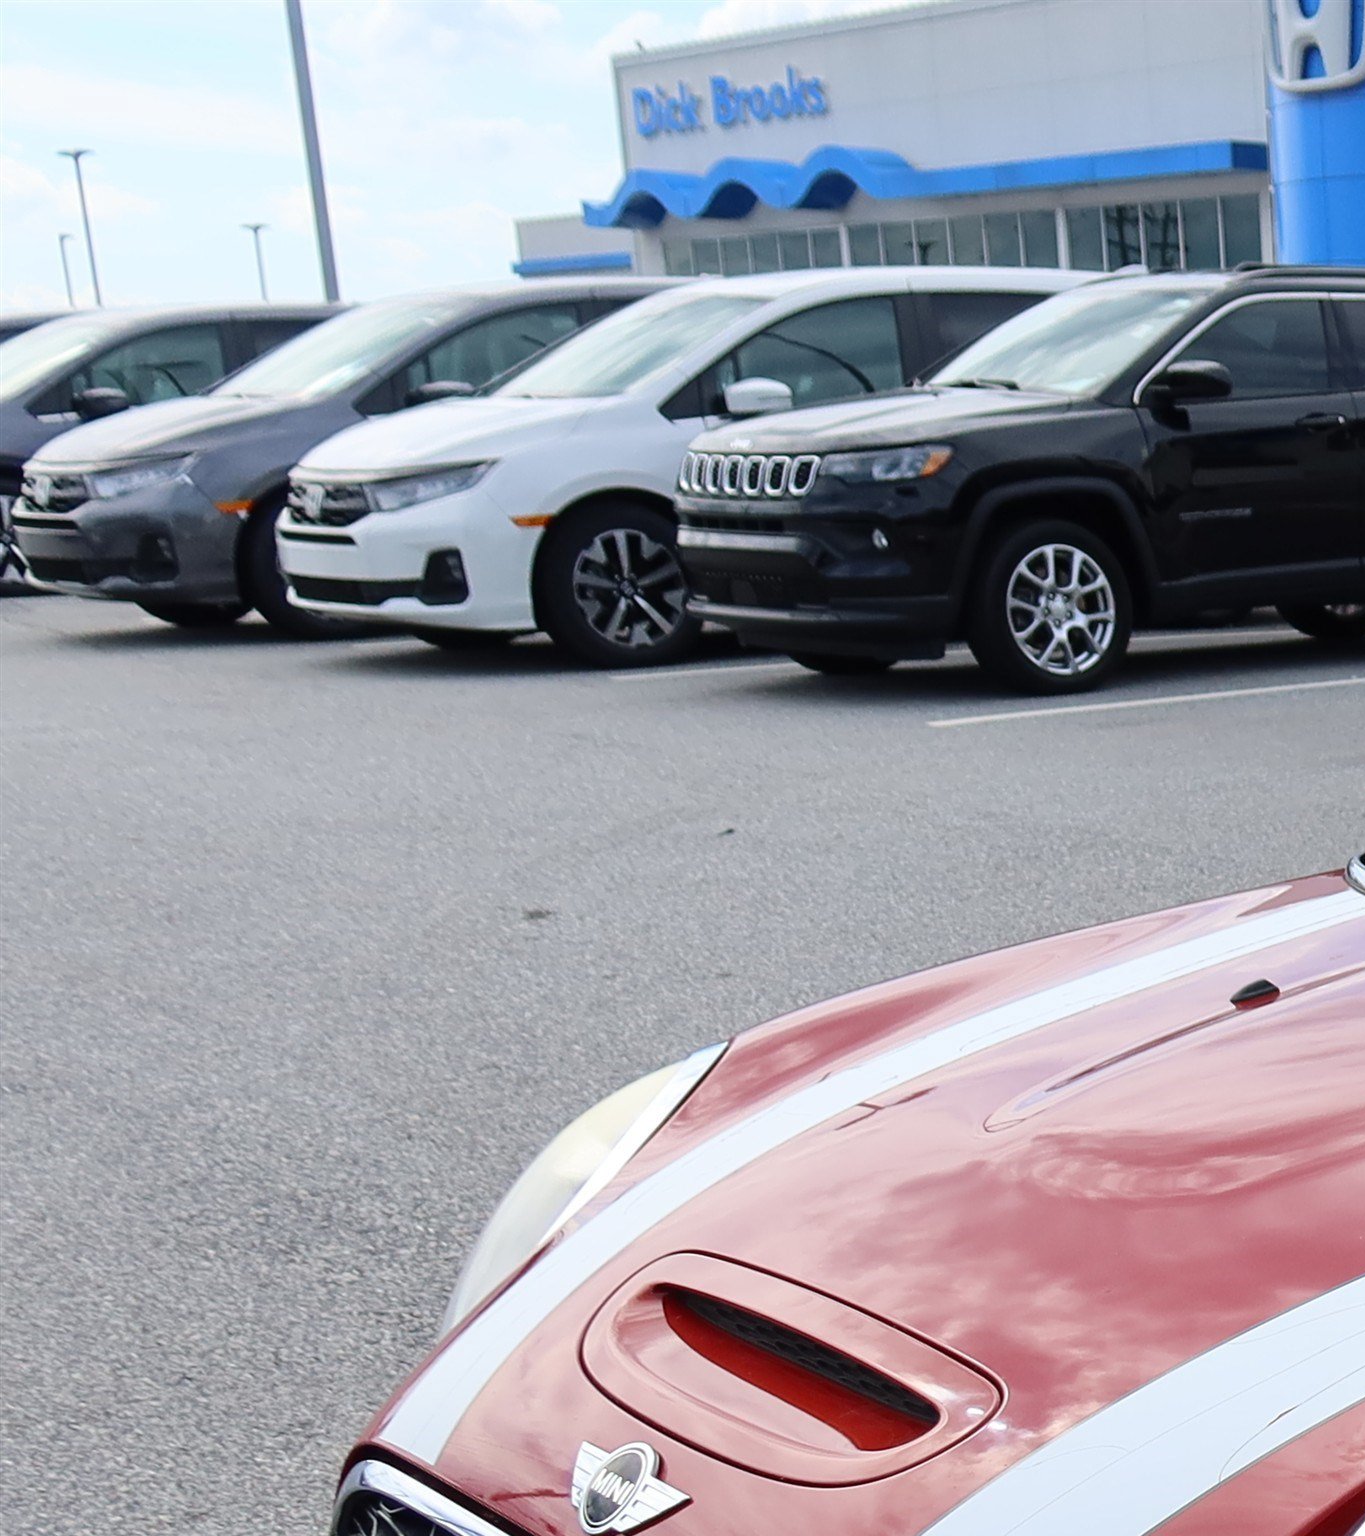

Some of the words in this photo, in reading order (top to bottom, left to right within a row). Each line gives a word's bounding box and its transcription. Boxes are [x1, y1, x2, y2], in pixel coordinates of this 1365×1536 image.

[631, 80, 703, 137] Dick
[708, 64, 831, 127] Brooks
[591, 1467, 635, 1506] MINI
